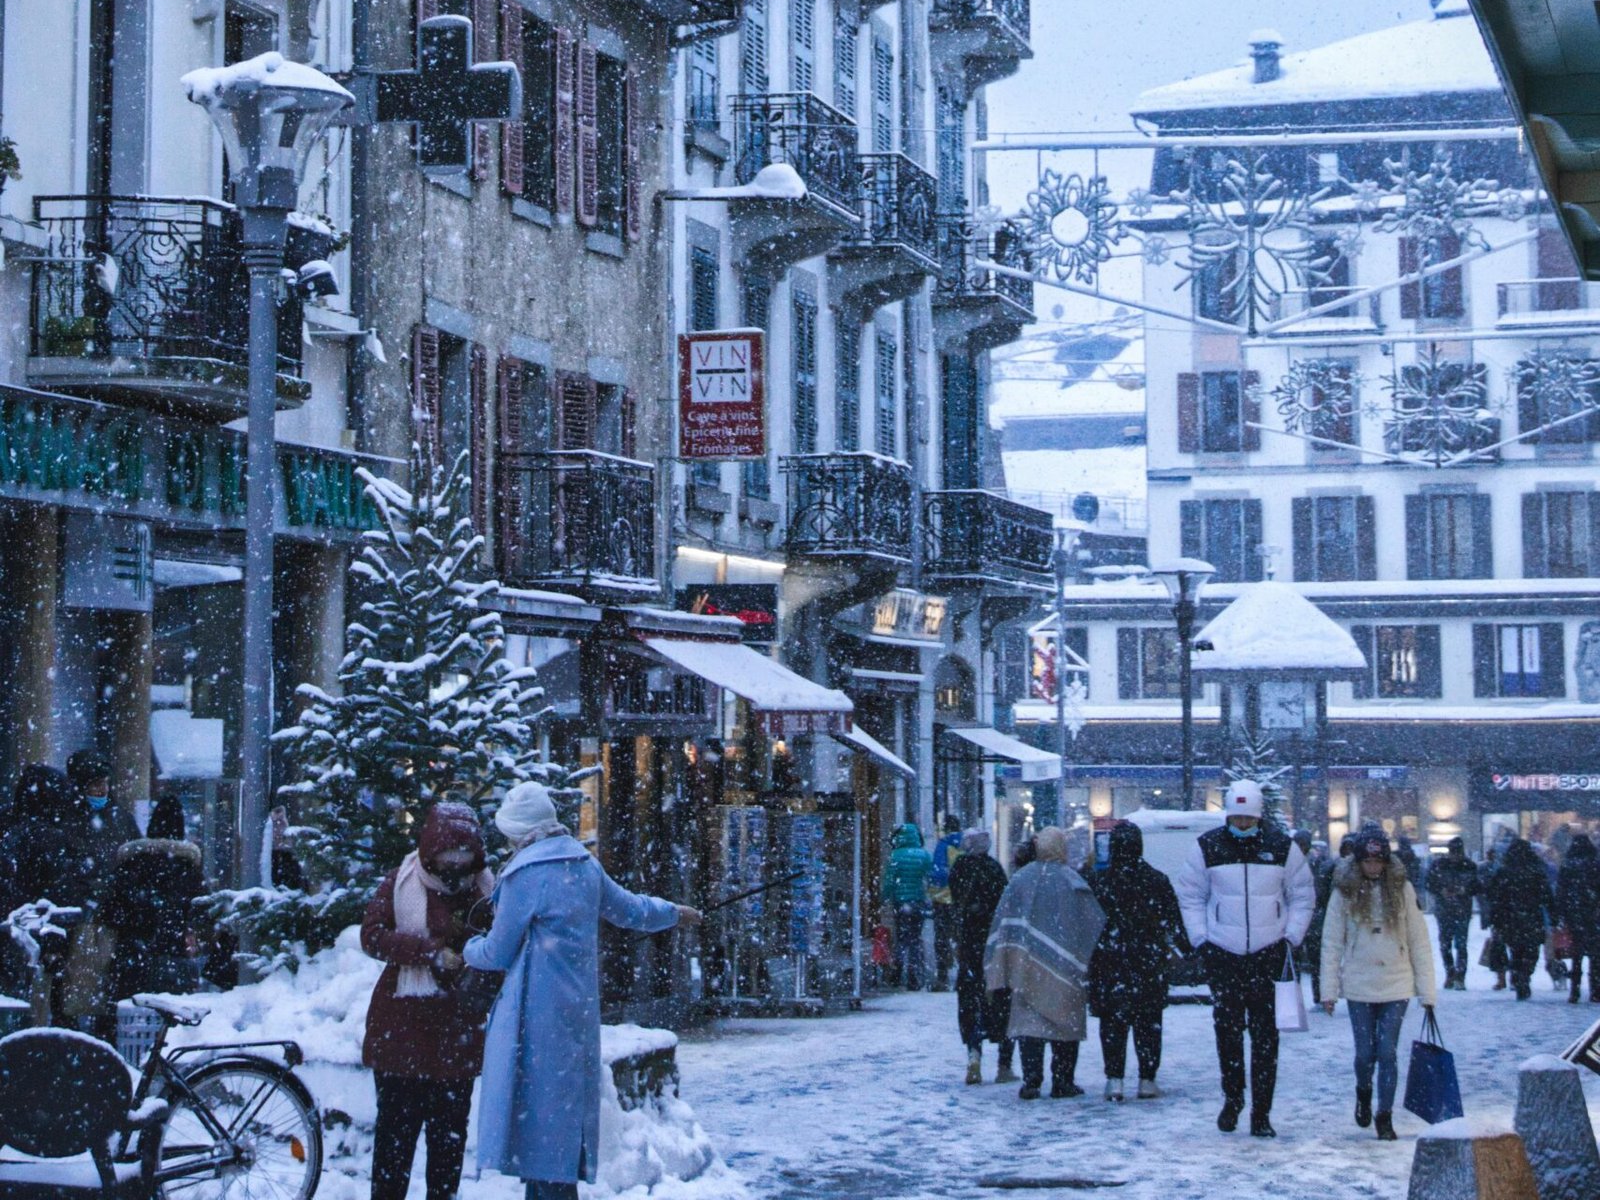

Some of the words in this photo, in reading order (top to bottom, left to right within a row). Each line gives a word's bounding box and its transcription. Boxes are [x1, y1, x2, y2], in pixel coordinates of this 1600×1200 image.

[696, 345, 747, 366] VIN
[696, 376, 747, 397] VIN
[688, 411, 718, 421] Cave
[730, 411, 757, 420] vins
[735, 424, 760, 436] fine
[691, 443, 752, 455] Fromages
